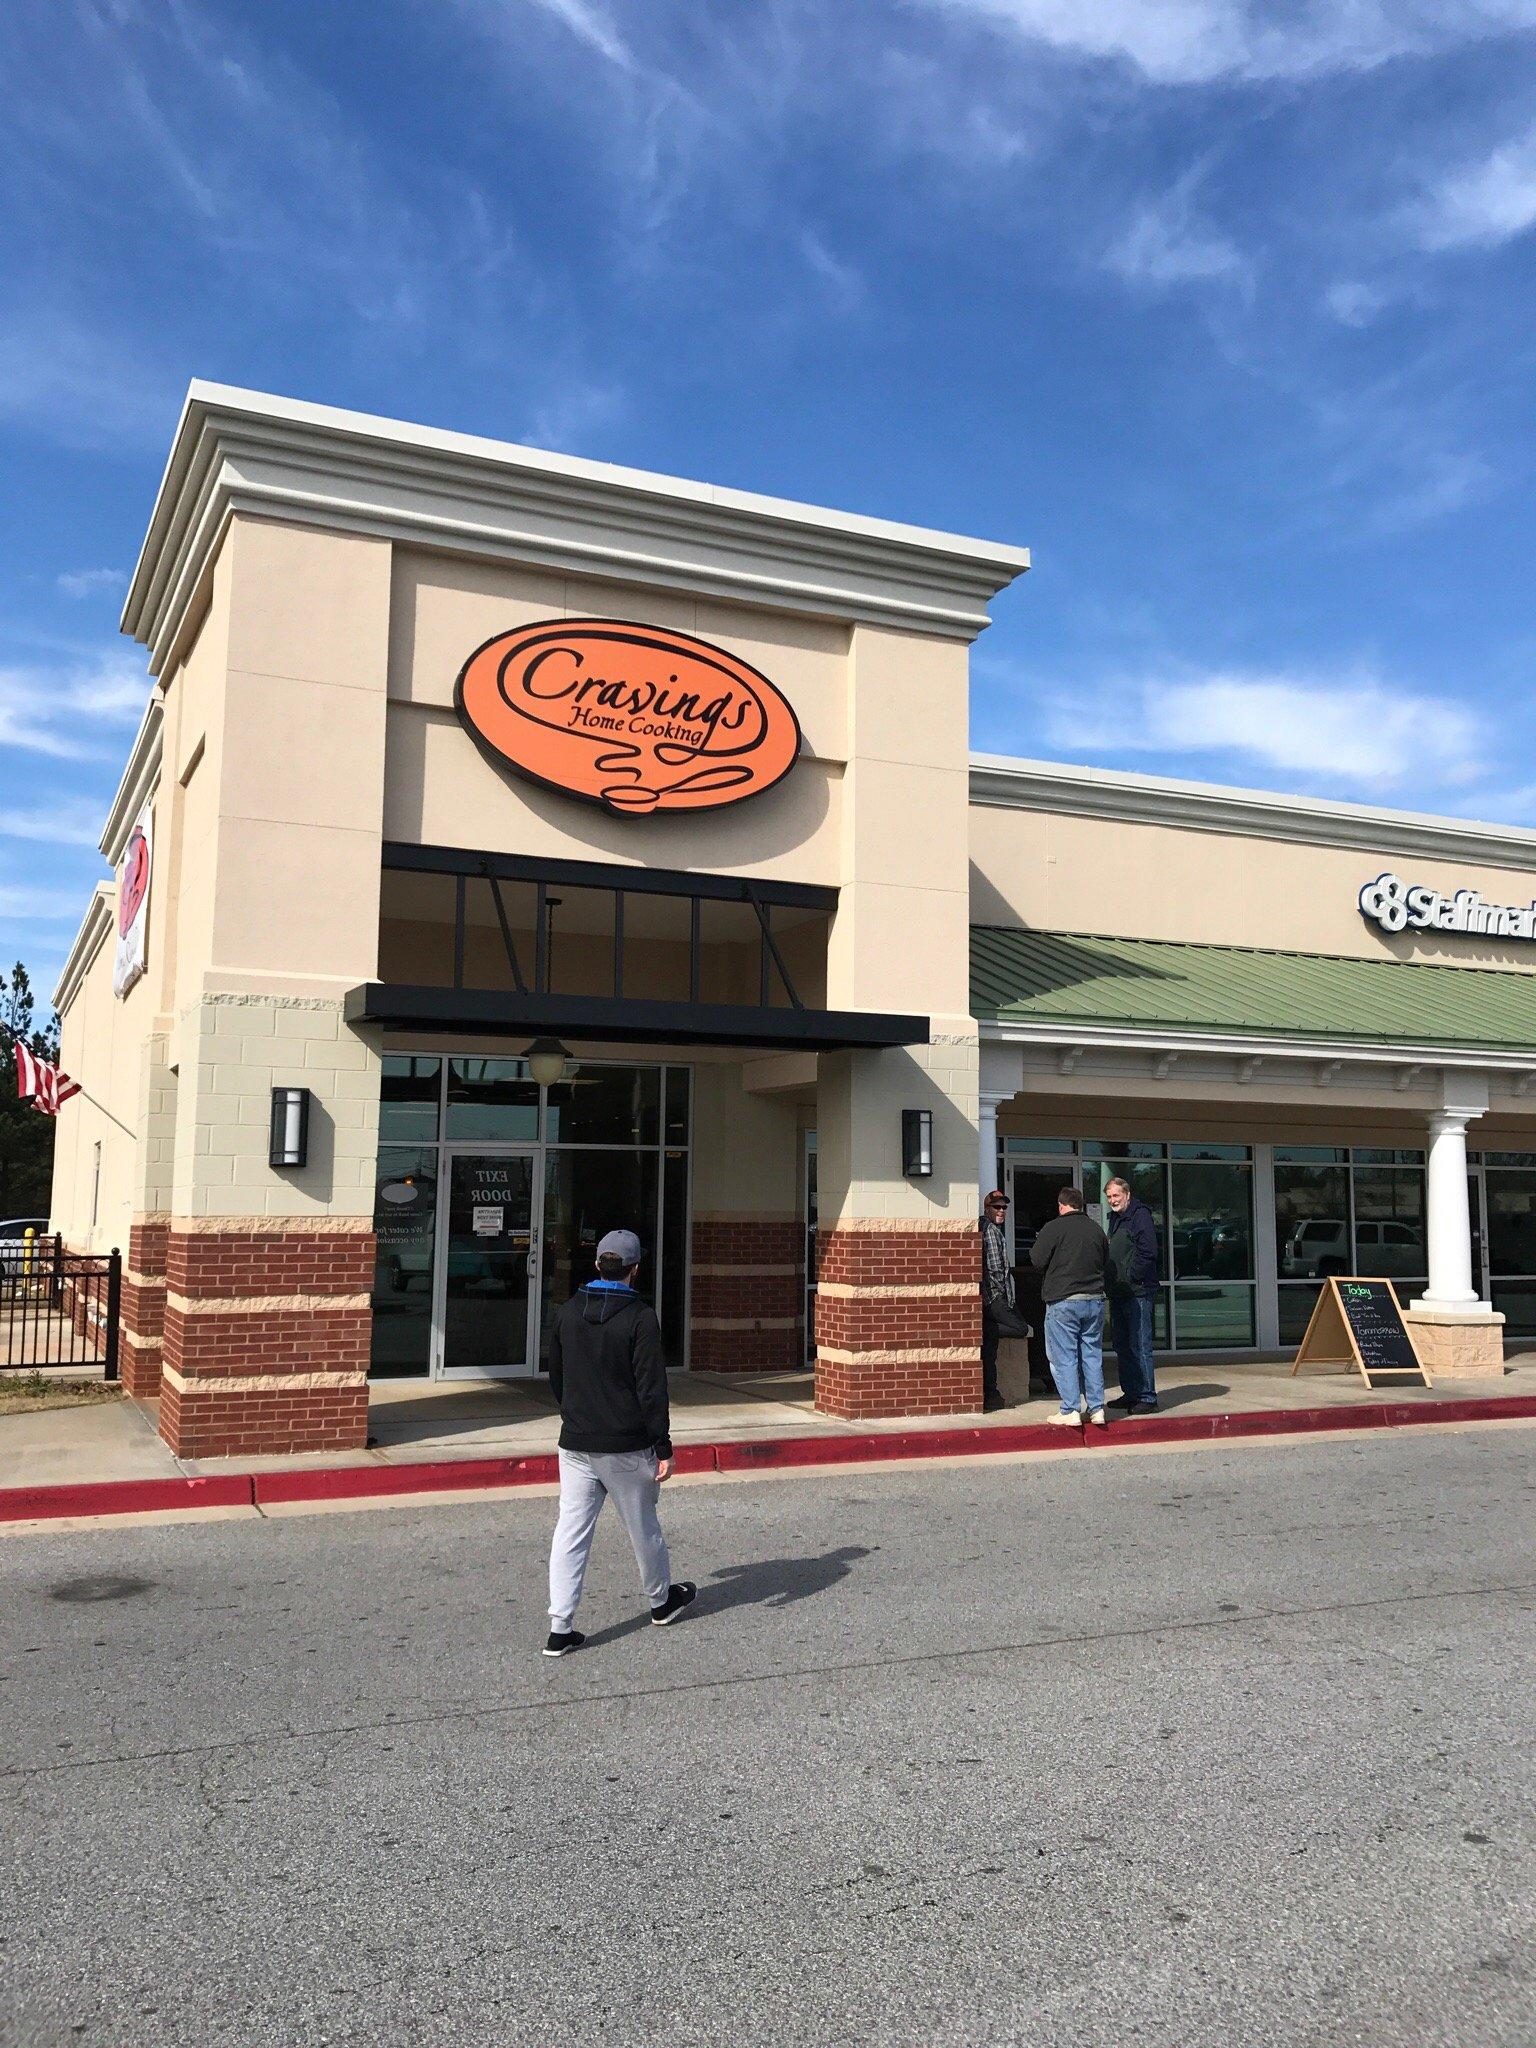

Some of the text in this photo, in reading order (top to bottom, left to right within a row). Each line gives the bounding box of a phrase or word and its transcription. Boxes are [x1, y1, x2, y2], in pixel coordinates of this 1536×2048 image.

[522, 647, 752, 748] Cravings
[567, 705, 704, 746] Home Cooking
[1407, 886, 1536, 940] Staffmar
[1343, 1284, 1372, 1299] Today
